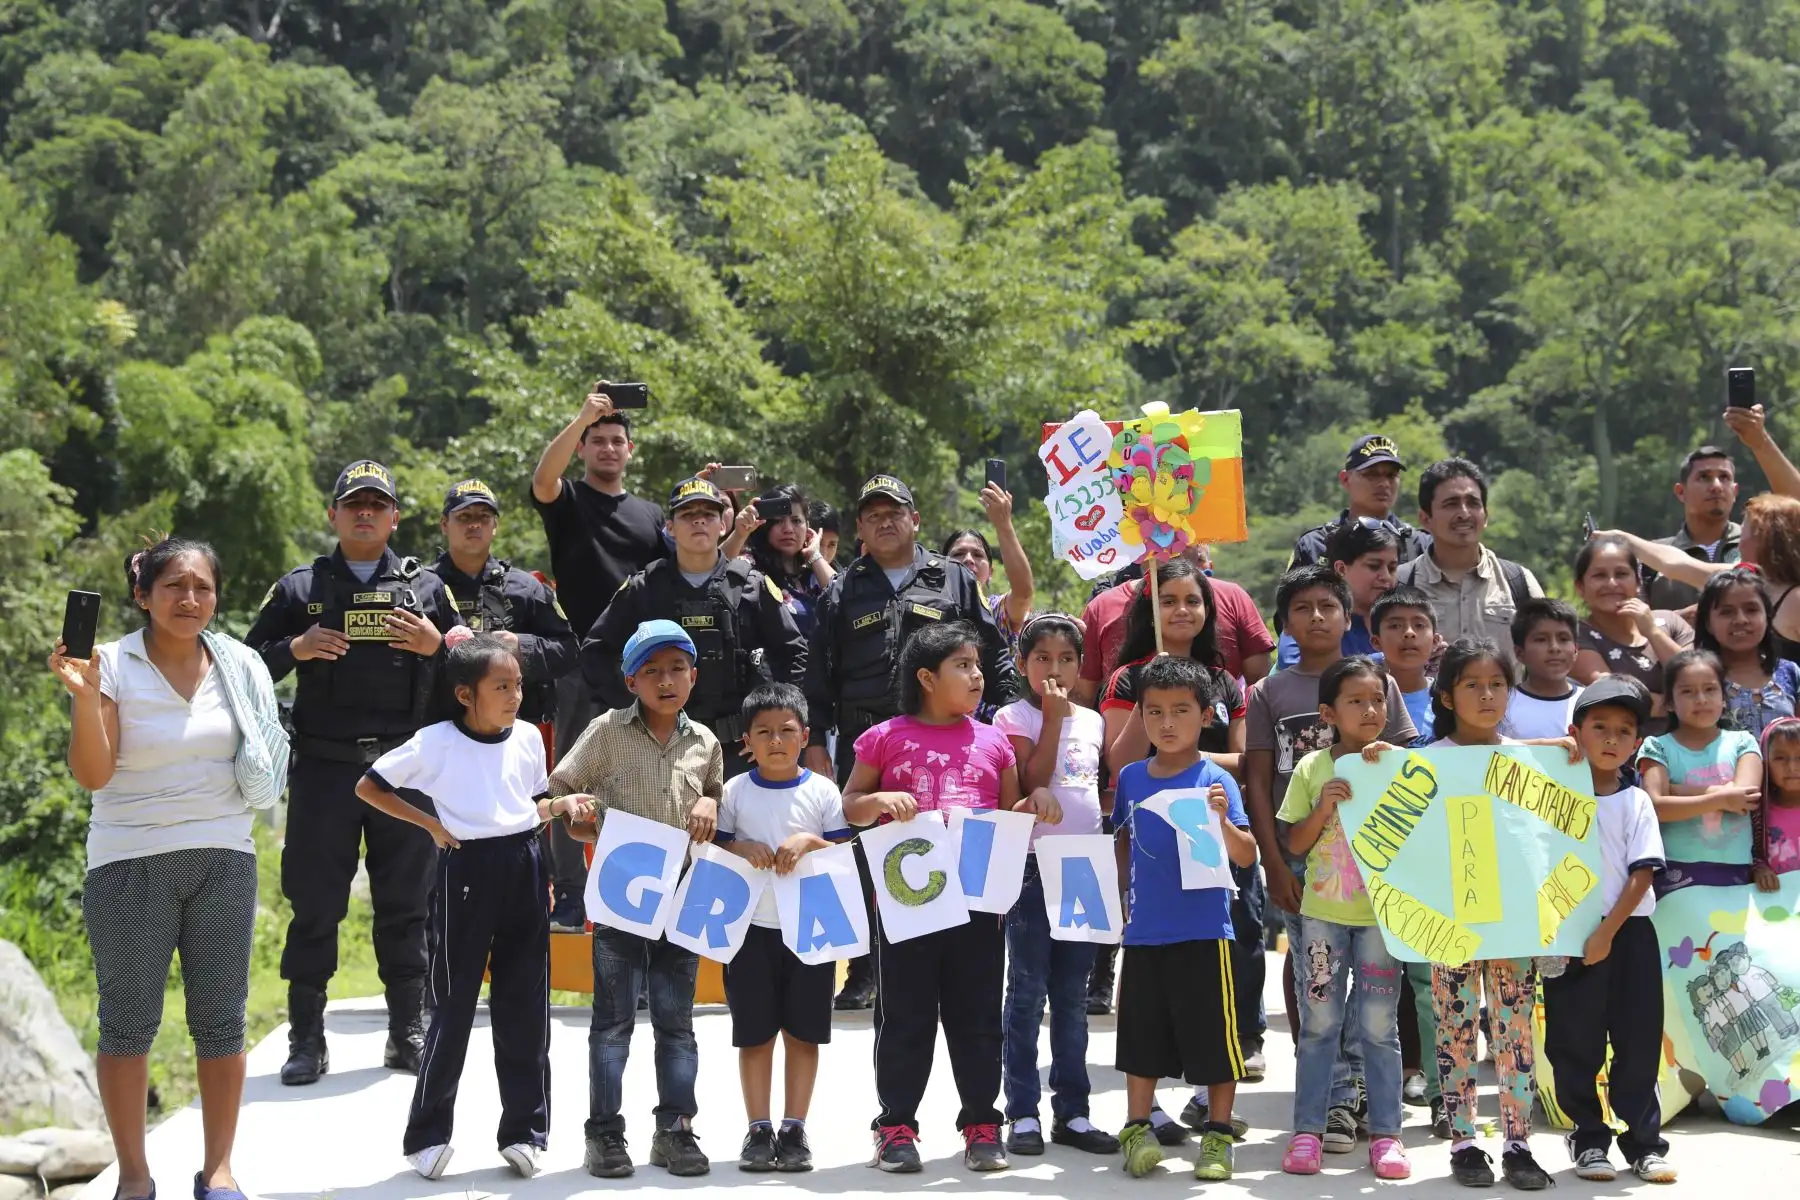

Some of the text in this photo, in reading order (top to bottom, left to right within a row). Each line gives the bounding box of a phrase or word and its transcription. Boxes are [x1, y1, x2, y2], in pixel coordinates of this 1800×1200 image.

[1361, 437, 1398, 458] POLICIA
[346, 463, 390, 488] POLICIA
[456, 480, 496, 502] POLICIA
[678, 480, 715, 500] POLICIA
[348, 613, 390, 626] POLIC
[1352, 759, 1439, 872] CAMINOS
[1461, 801, 1478, 908] PARA
[1368, 875, 1471, 967] PERSONAS
